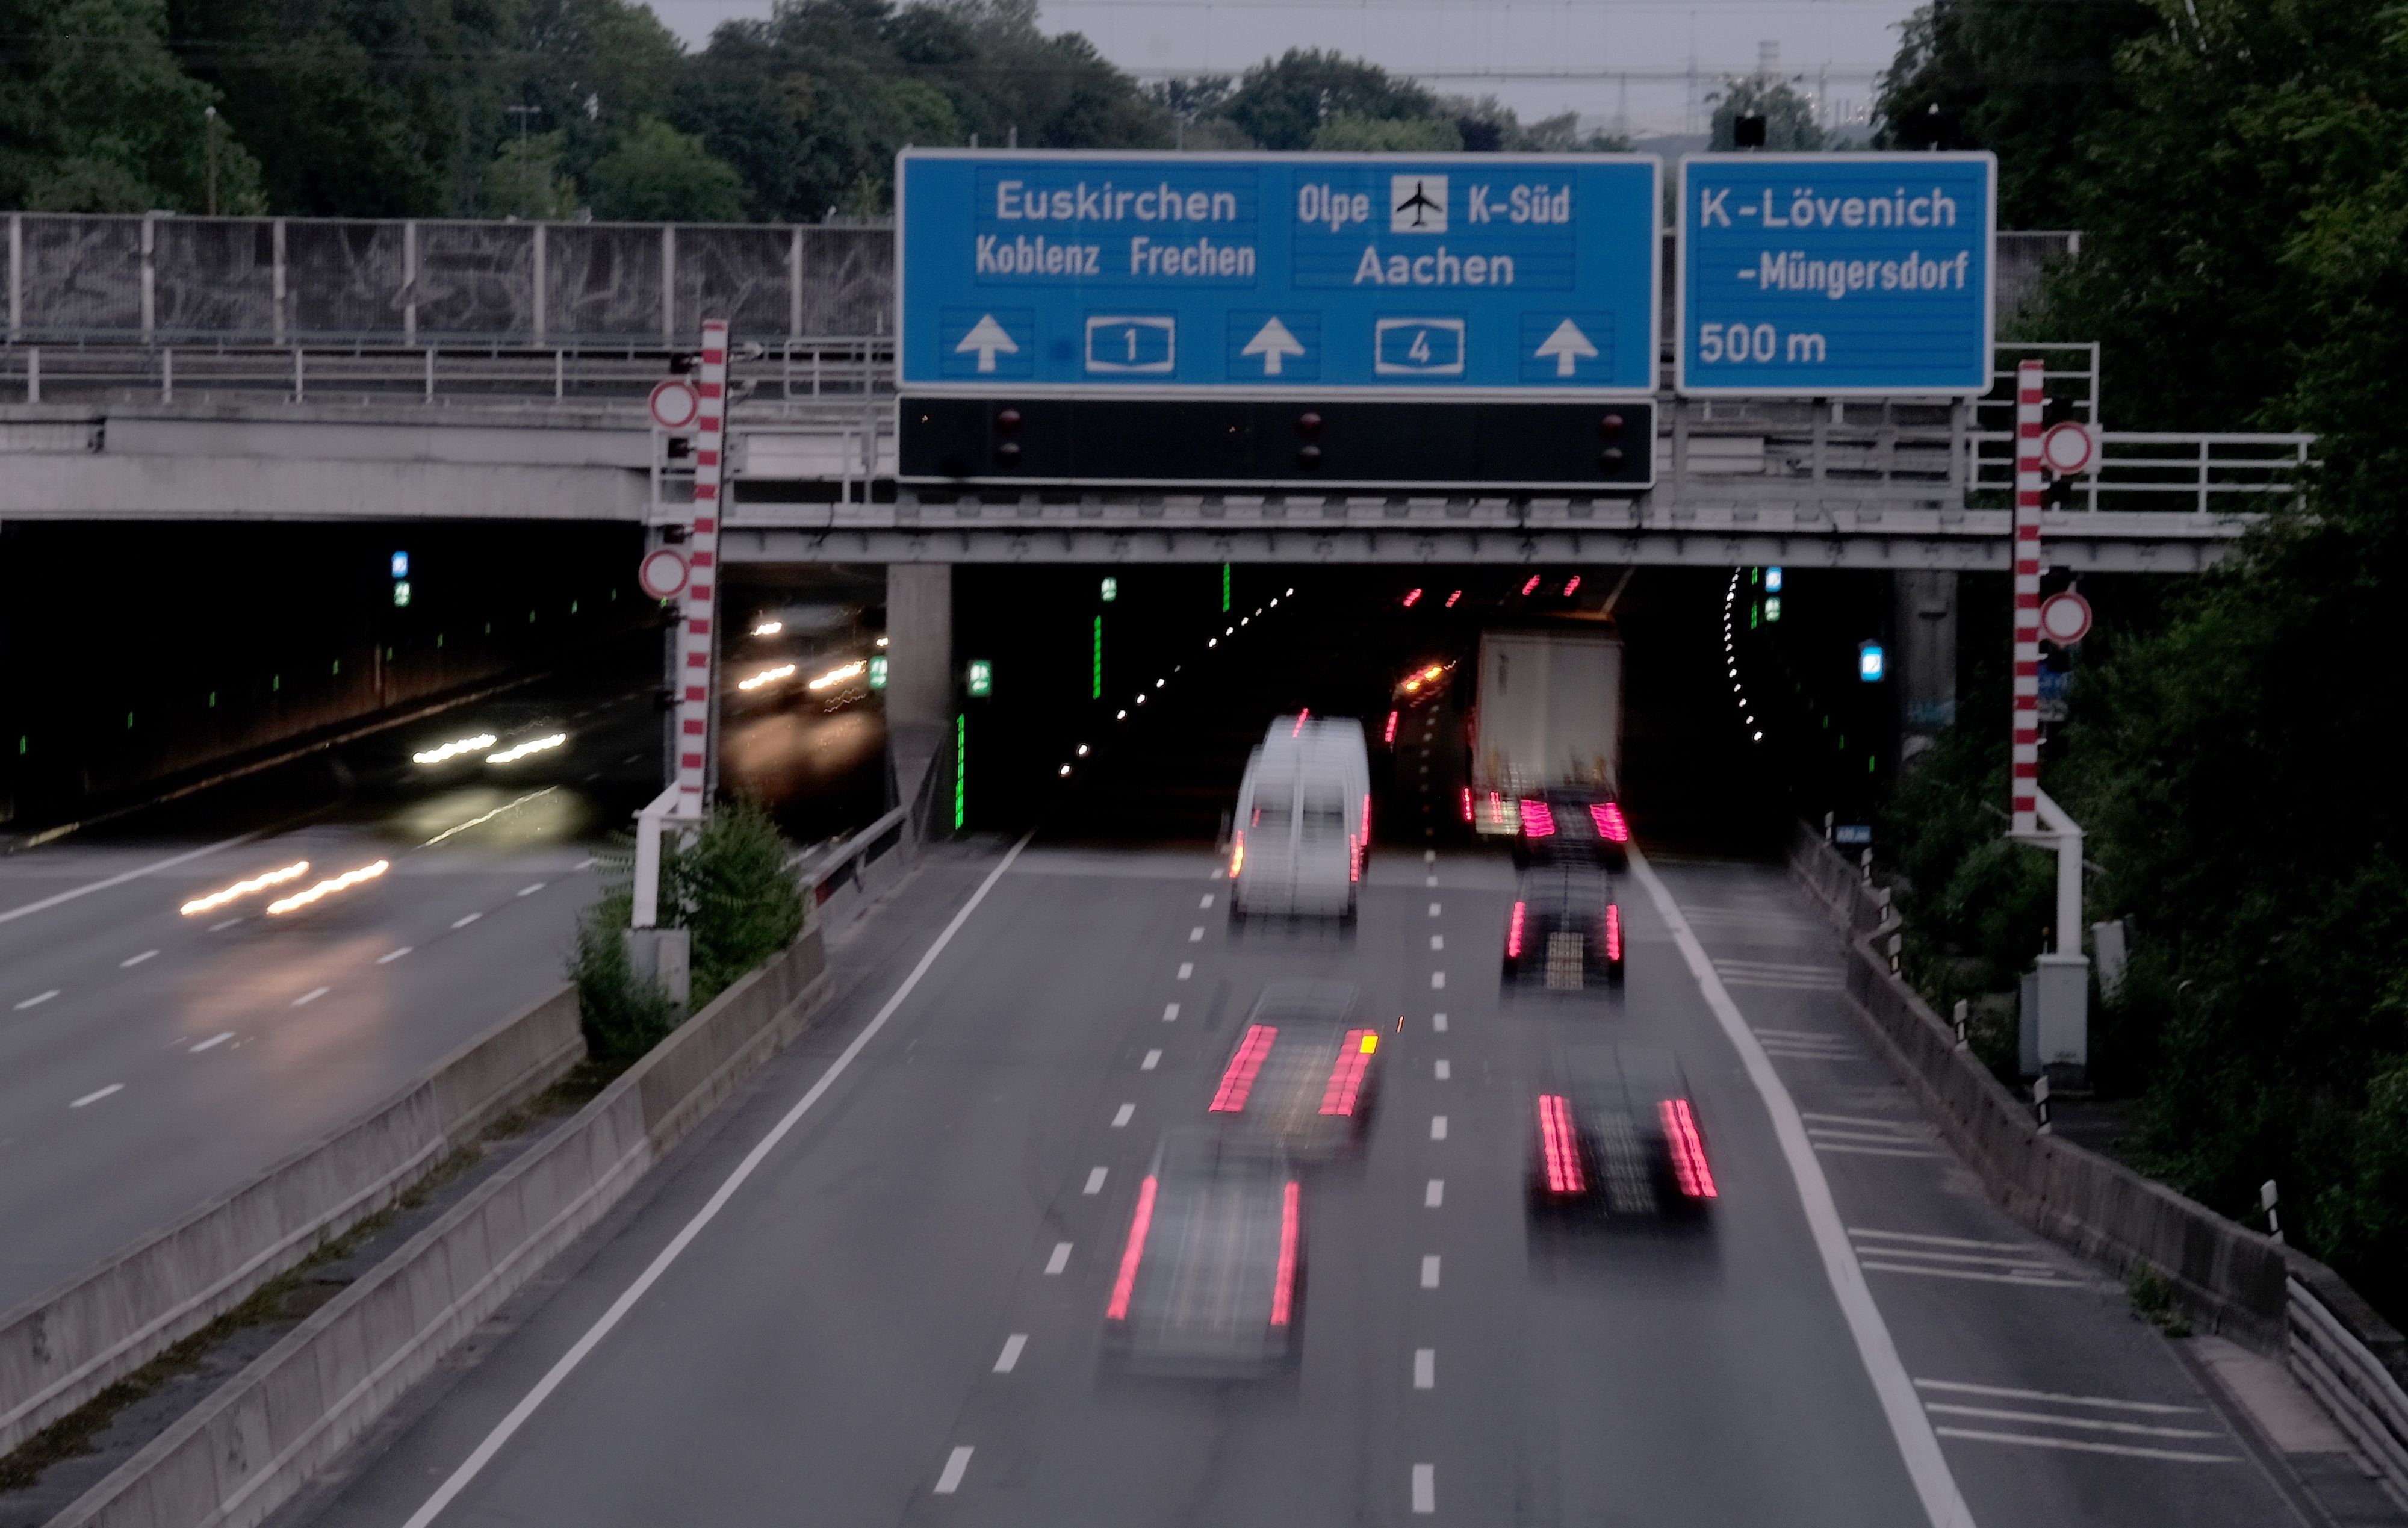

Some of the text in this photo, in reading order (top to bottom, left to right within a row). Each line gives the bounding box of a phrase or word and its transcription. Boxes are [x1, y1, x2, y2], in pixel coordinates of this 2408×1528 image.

[999, 182, 1235, 220] Euskirchen
[1299, 185, 1569, 232] Olpe K-Süd
[1702, 189, 1956, 227] K-Lövenich
[977, 236, 1255, 275] Koblenz Frechen
[1354, 247, 1513, 284] Aachen
[1739, 252, 1968, 299] -Müngersdorf
[1125, 329, 1136, 361] 1
[1408, 331, 1430, 362] 4
[1701, 324, 1826, 362] 500 m
